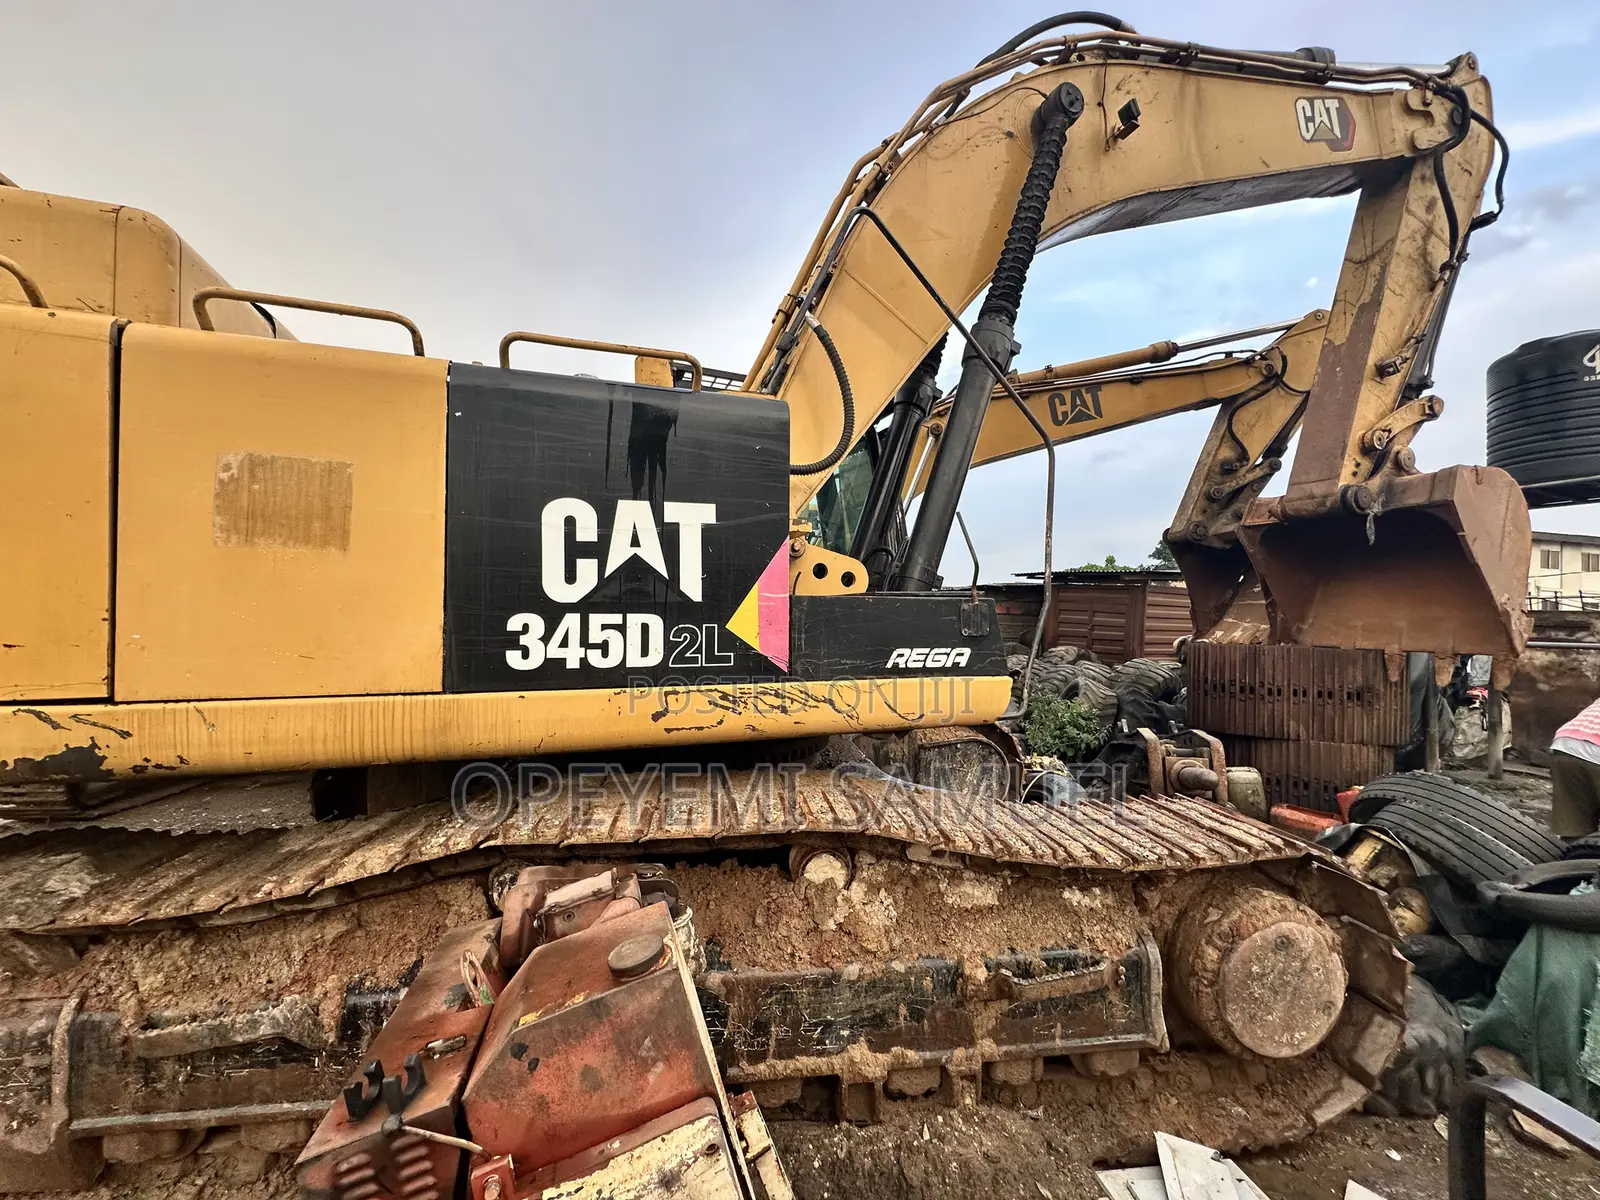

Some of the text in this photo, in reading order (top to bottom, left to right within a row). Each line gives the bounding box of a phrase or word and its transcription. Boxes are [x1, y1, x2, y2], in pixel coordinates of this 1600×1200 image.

[1296, 98, 1341, 140] CAT
[1048, 385, 1103, 427] CAT
[541, 497, 716, 604] CAT
[505, 612, 734, 671] 345D 2L
[885, 647, 971, 669] REGA
